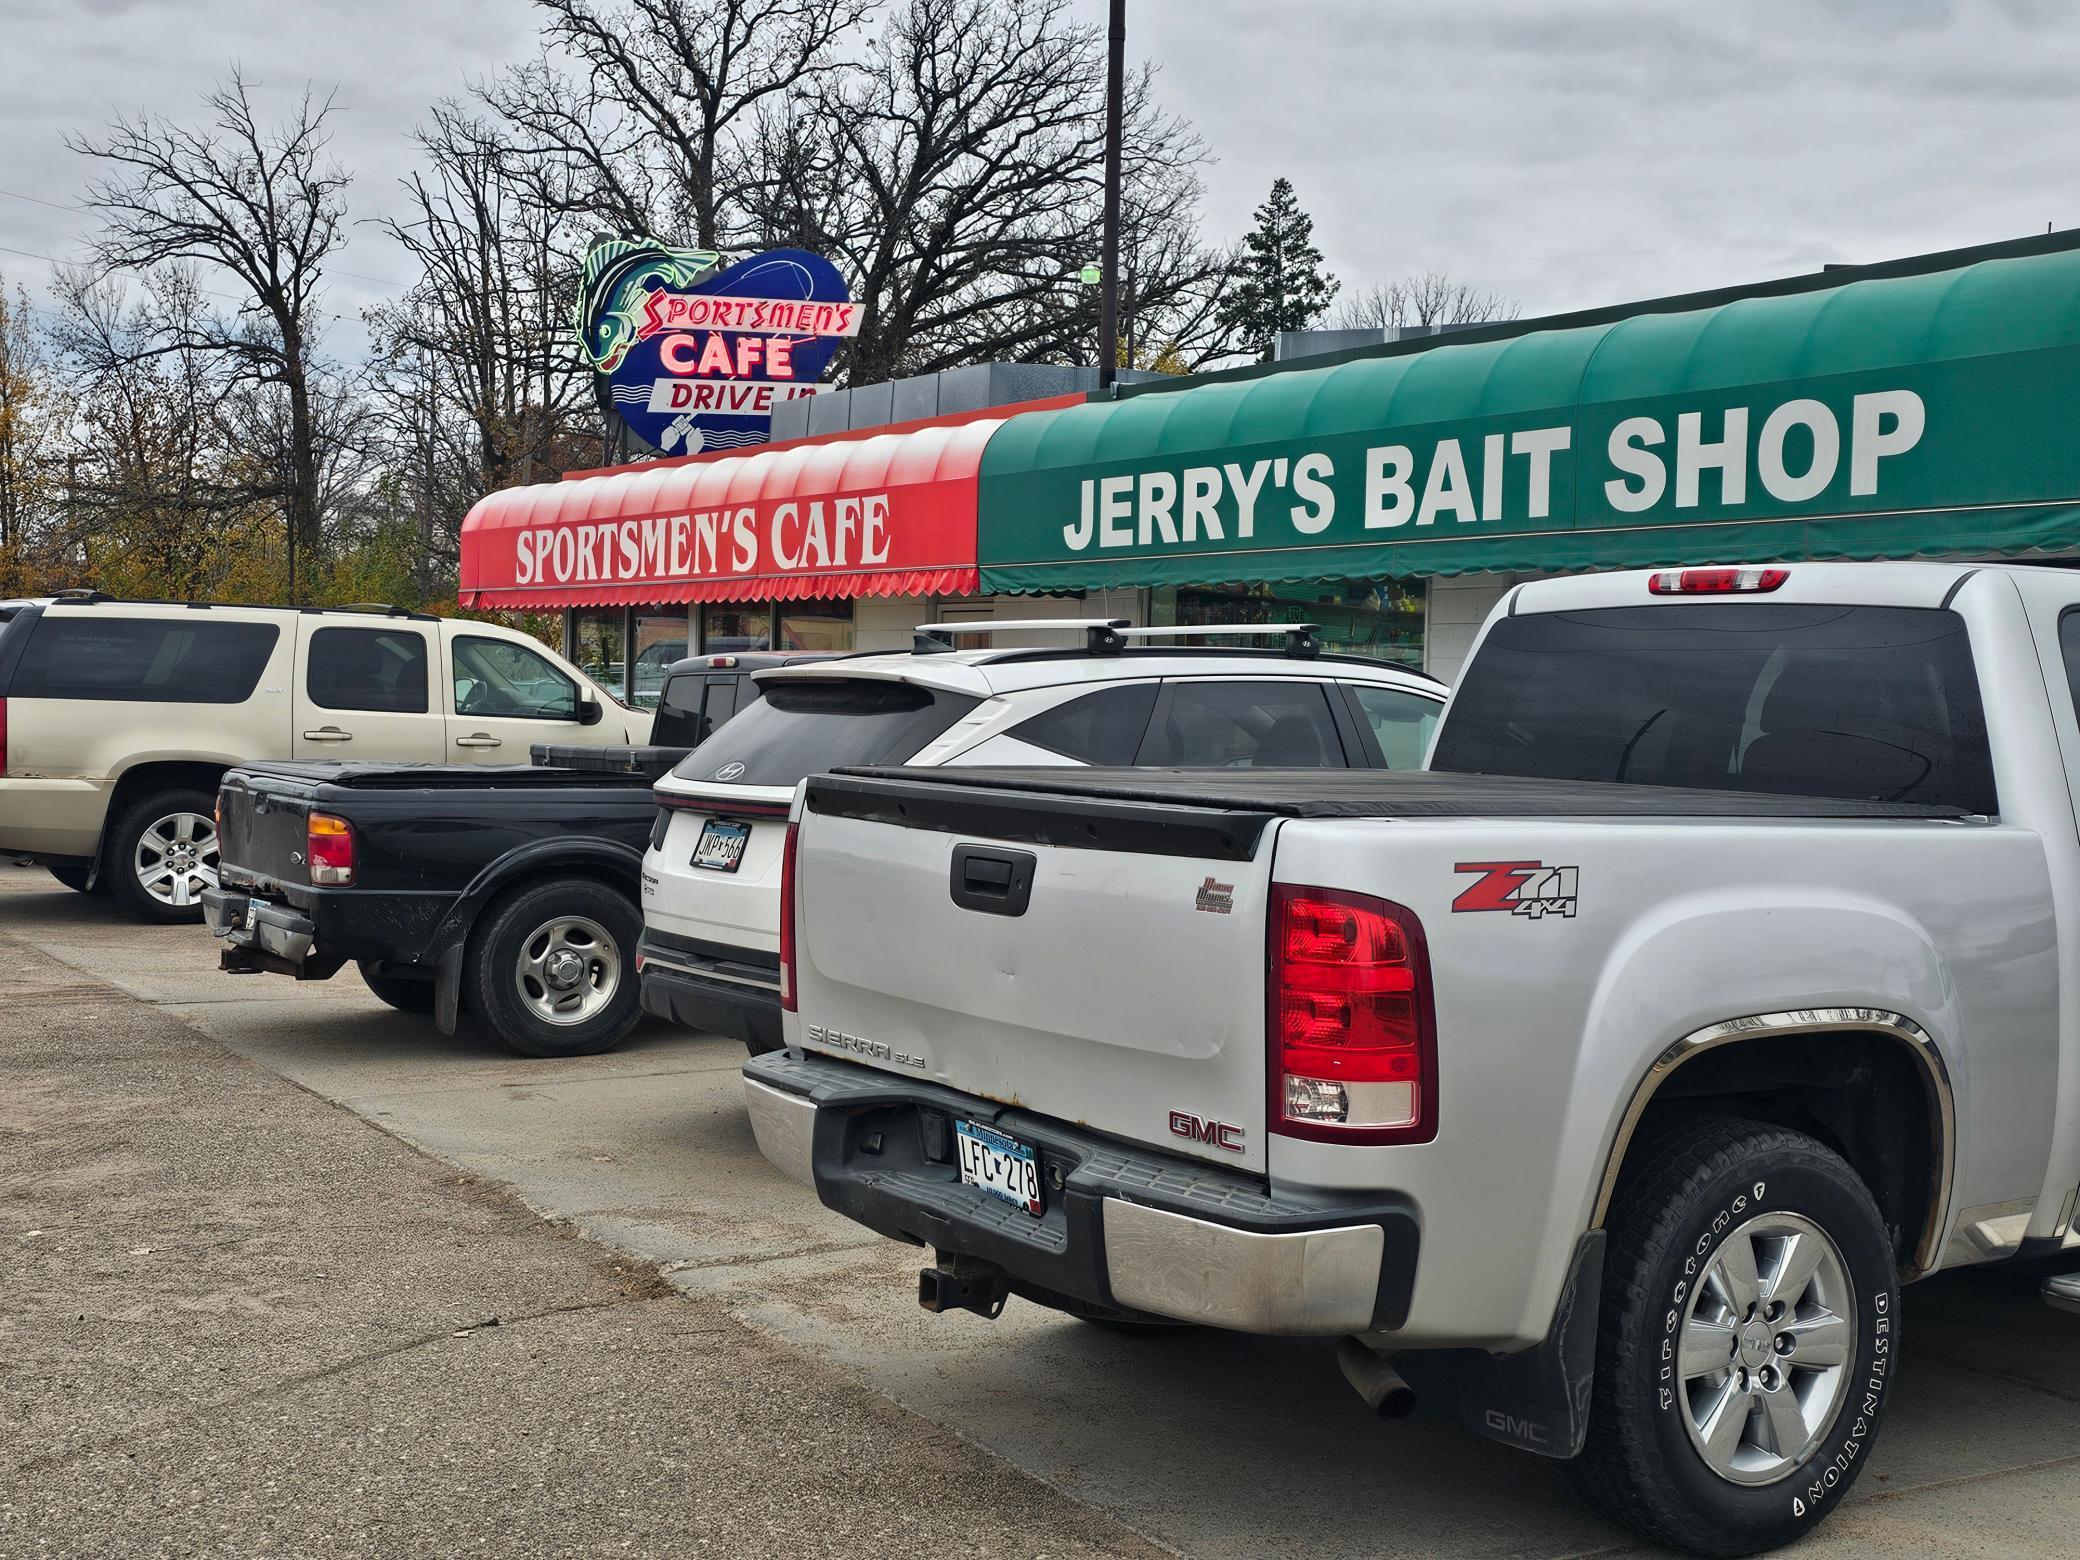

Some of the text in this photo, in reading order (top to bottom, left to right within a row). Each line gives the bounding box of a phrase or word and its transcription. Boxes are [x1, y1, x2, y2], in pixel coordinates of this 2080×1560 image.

[659, 333, 794, 379] CAFE
[670, 383, 775, 411] DRIVE
[1062, 389, 1927, 552] JERRY'S BAIT SHOP
[515, 493, 891, 584] SPORTSMEN'S CAFE
[1451, 860, 1579, 913] Z71
[808, 1024, 925, 1069] SIERRA SLE
[1168, 1109, 1246, 1154] GMC
[960, 1135, 1038, 1200] LFC 278
[1808, 1292, 1890, 1505] DESTINATION
[1486, 1409, 1548, 1444] GMC
